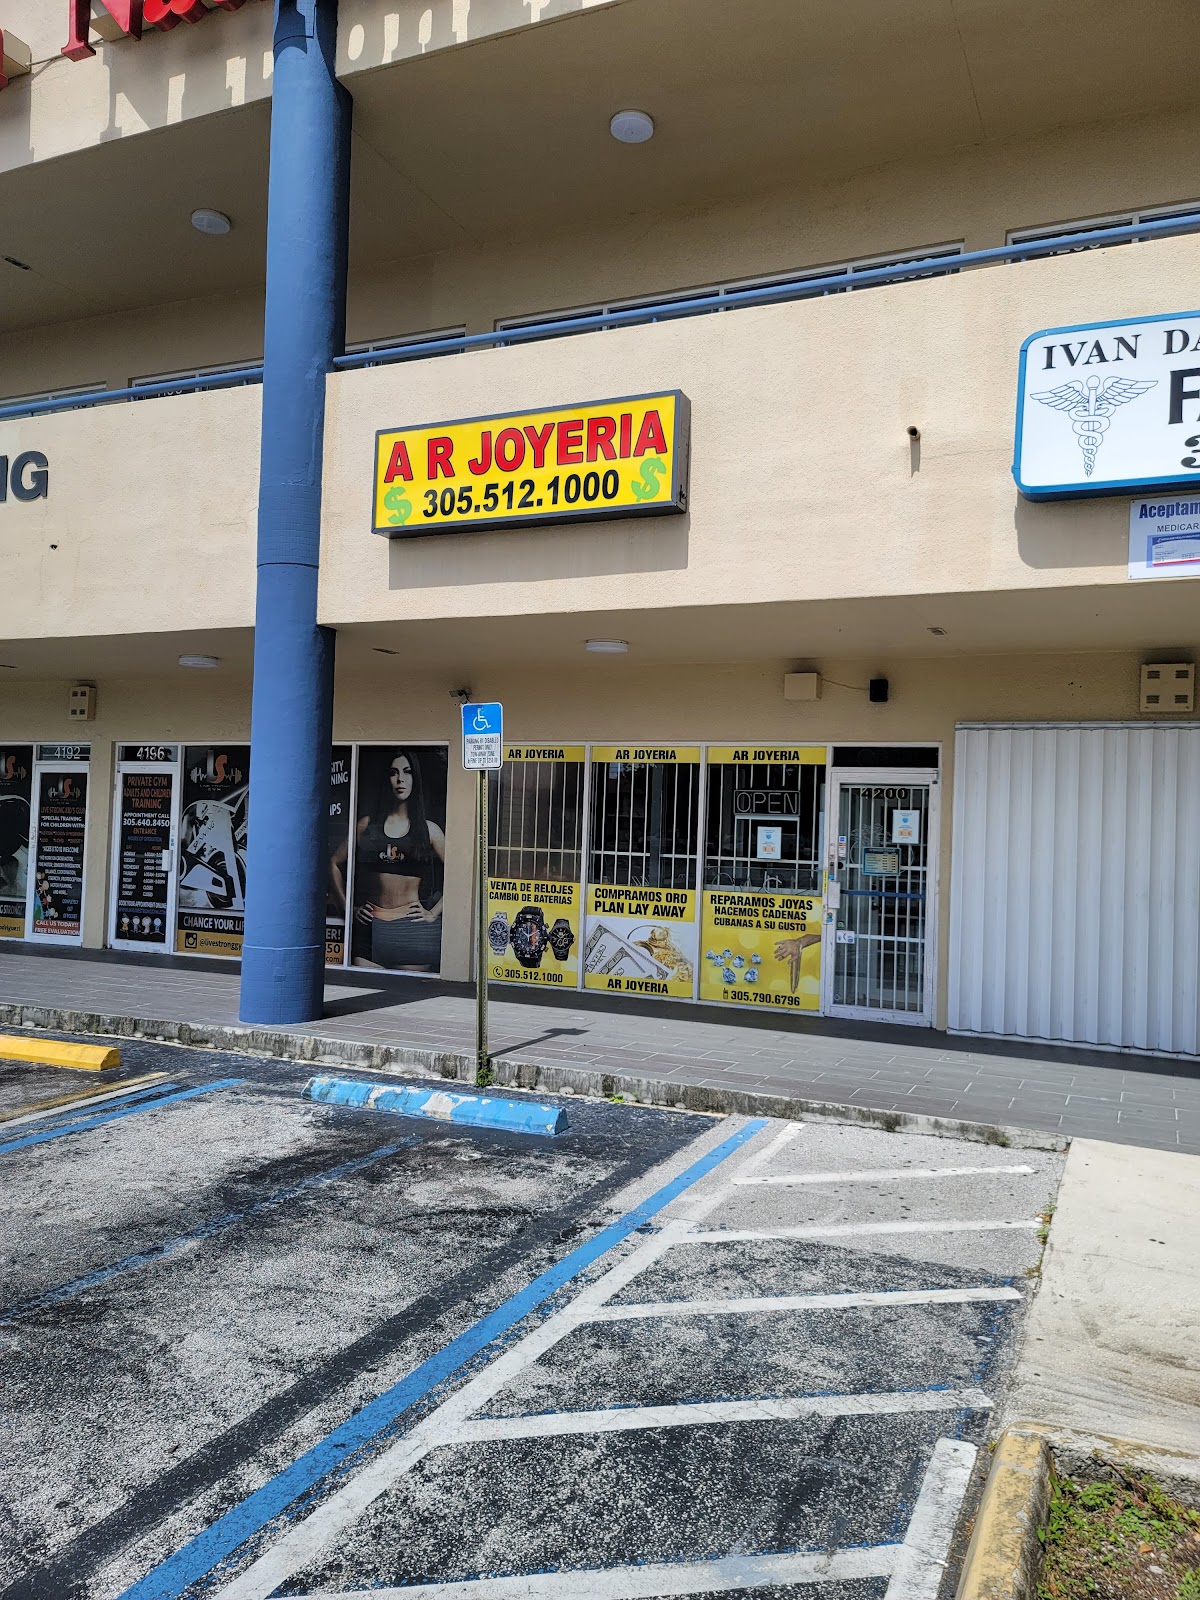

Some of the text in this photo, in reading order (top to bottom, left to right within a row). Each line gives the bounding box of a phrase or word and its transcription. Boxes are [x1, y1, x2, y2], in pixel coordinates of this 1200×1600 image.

[1042, 334, 1142, 370] IVAN
[1168, 367, 1200, 425] F
[384, 409, 668, 483] A R JOYERIA
[423, 469, 620, 517] 305.512.1000
[54, 746, 81, 759] 4192
[137, 746, 165, 760] 4196
[508, 749, 564, 759] AR JOYERIA
[615, 750, 676, 760] AR JOYERIA
[733, 750, 800, 761] AR JOYERIA
[128, 776, 167, 786] PRIVATE GYM
[861, 788, 909, 800] 4200
[132, 798, 161, 809] TRAINING
[737, 792, 797, 814] OPEN
[123, 818, 170, 827] 305.640.8450
[490, 881, 573, 895] VENTA DE RELOJES
[489, 892, 572, 905] CAMBIO DE BATERIAS
[595, 888, 687, 904] COMPRAMOS ORO
[710, 894, 813, 910] REPARAMOS JOYAS
[594, 901, 686, 918] PLAN LAY AWAY
[714, 906, 807, 921] HACEMOS CADENAS
[184, 916, 213, 928] CHANGE
[214, 918, 234, 930] YOUR
[714, 917, 806, 931] CUBANAS A SU GUSTO
[505, 968, 563, 983] 305.512.1000
[608, 978, 669, 993] AR JOYERIA
[731, 990, 800, 1006] 305.790.6796
